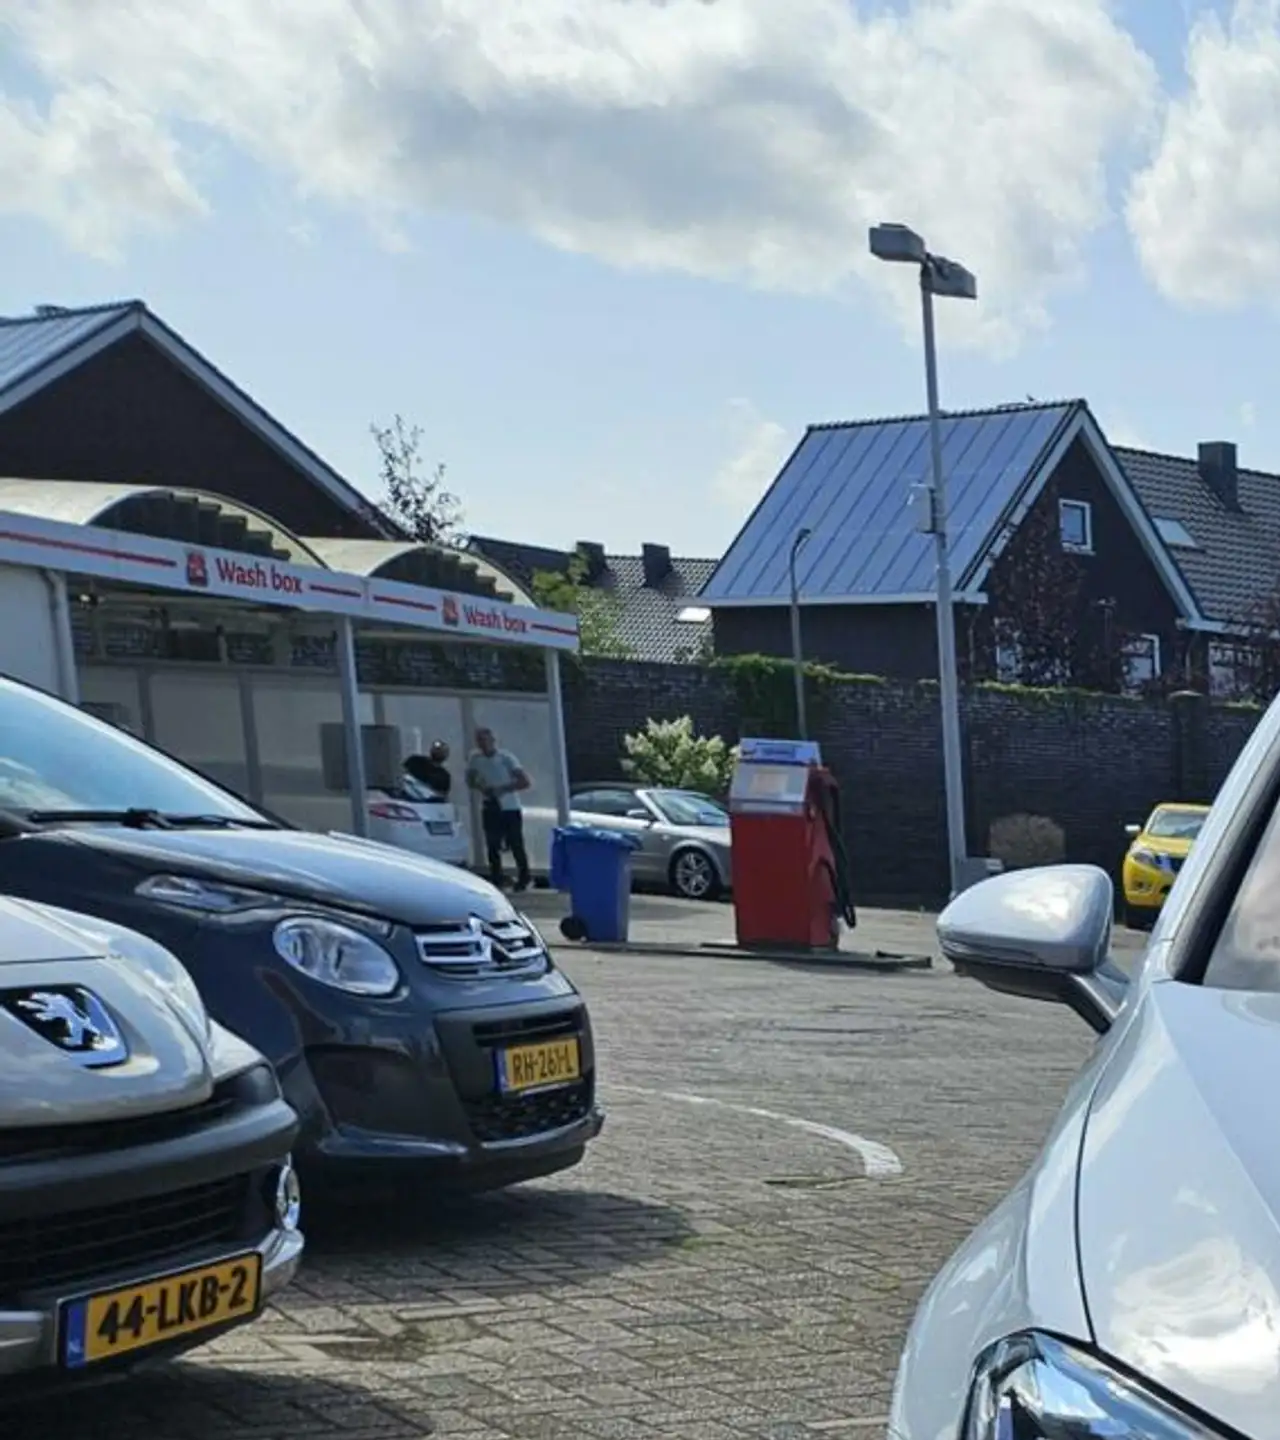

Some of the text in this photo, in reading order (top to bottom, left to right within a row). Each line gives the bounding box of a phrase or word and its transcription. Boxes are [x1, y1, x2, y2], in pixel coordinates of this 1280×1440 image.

[214, 557, 303, 593] Wash box
[462, 604, 528, 633] Wash box
[97, 1265, 249, 1344] 44-LKB-2
